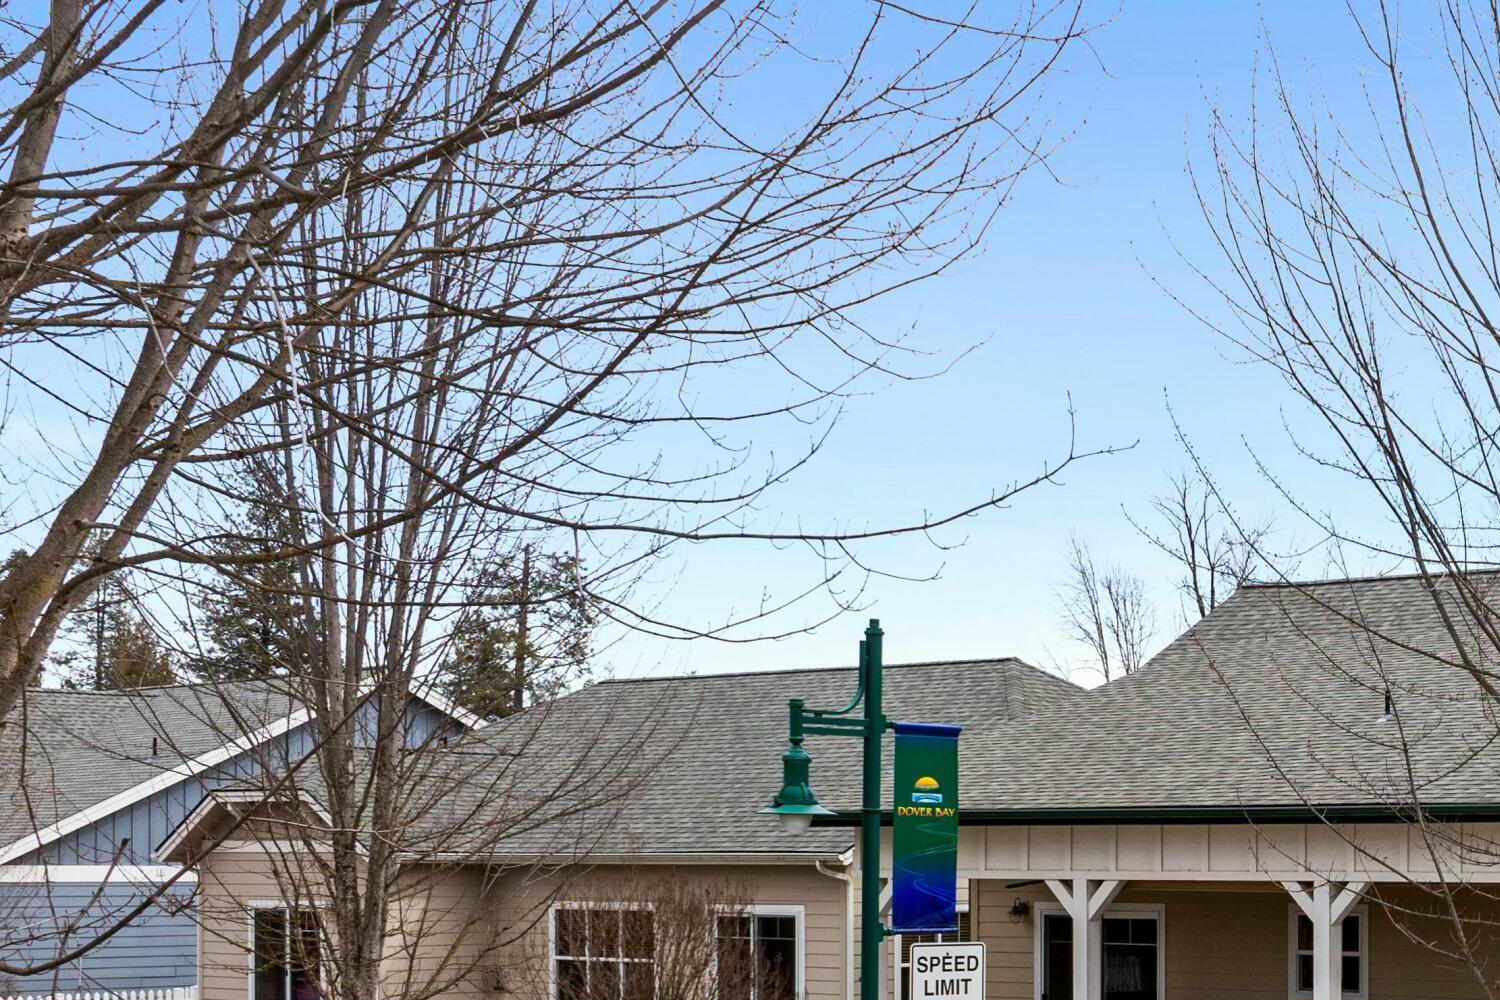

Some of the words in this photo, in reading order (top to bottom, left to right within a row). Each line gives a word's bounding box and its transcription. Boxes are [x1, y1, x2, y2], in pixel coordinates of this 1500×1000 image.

[897, 806, 933, 817] DOVER
[935, 807, 956, 817] BAY
[917, 955, 979, 973] SPEED
[924, 978, 973, 996] LIMIT
